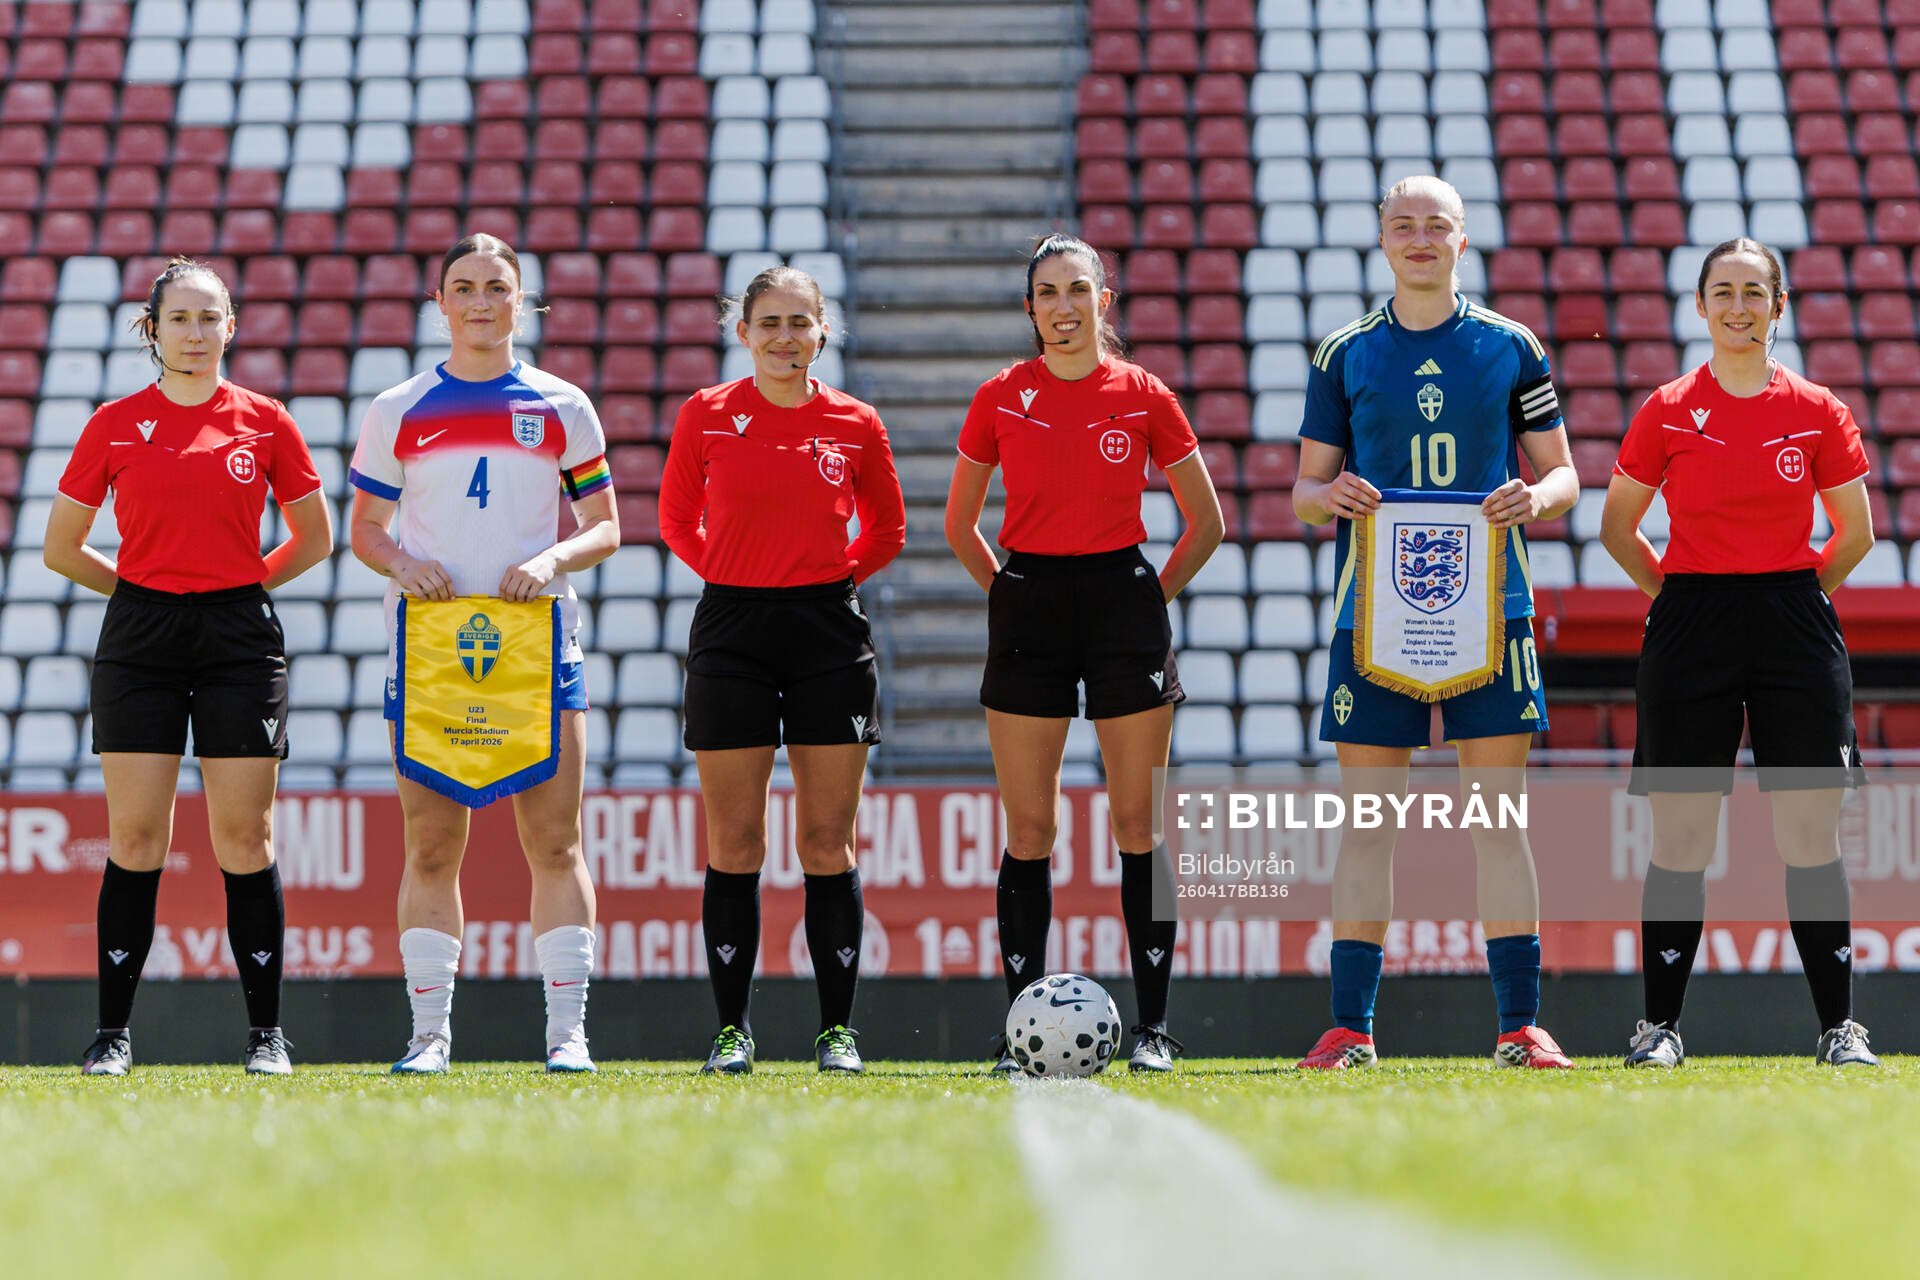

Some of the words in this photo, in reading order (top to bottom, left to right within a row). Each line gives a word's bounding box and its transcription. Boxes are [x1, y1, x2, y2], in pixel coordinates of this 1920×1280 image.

[1411, 433, 1456, 487] 10
[466, 456, 490, 509] 4
[463, 632, 495, 640] SVERIGE
[1435, 629, 1456, 637] Friendly
[1510, 637, 1540, 692] 10
[468, 706, 485, 714] U23
[466, 716, 487, 724] Final
[444, 727, 473, 735] Murcia
[474, 727, 509, 735] Stadium
[450, 737, 459, 745] 17
[460, 737, 479, 747] april
[481, 738, 502, 746] 2026
[583, 794, 704, 889] REAL
[940, 792, 1074, 888] CLB
